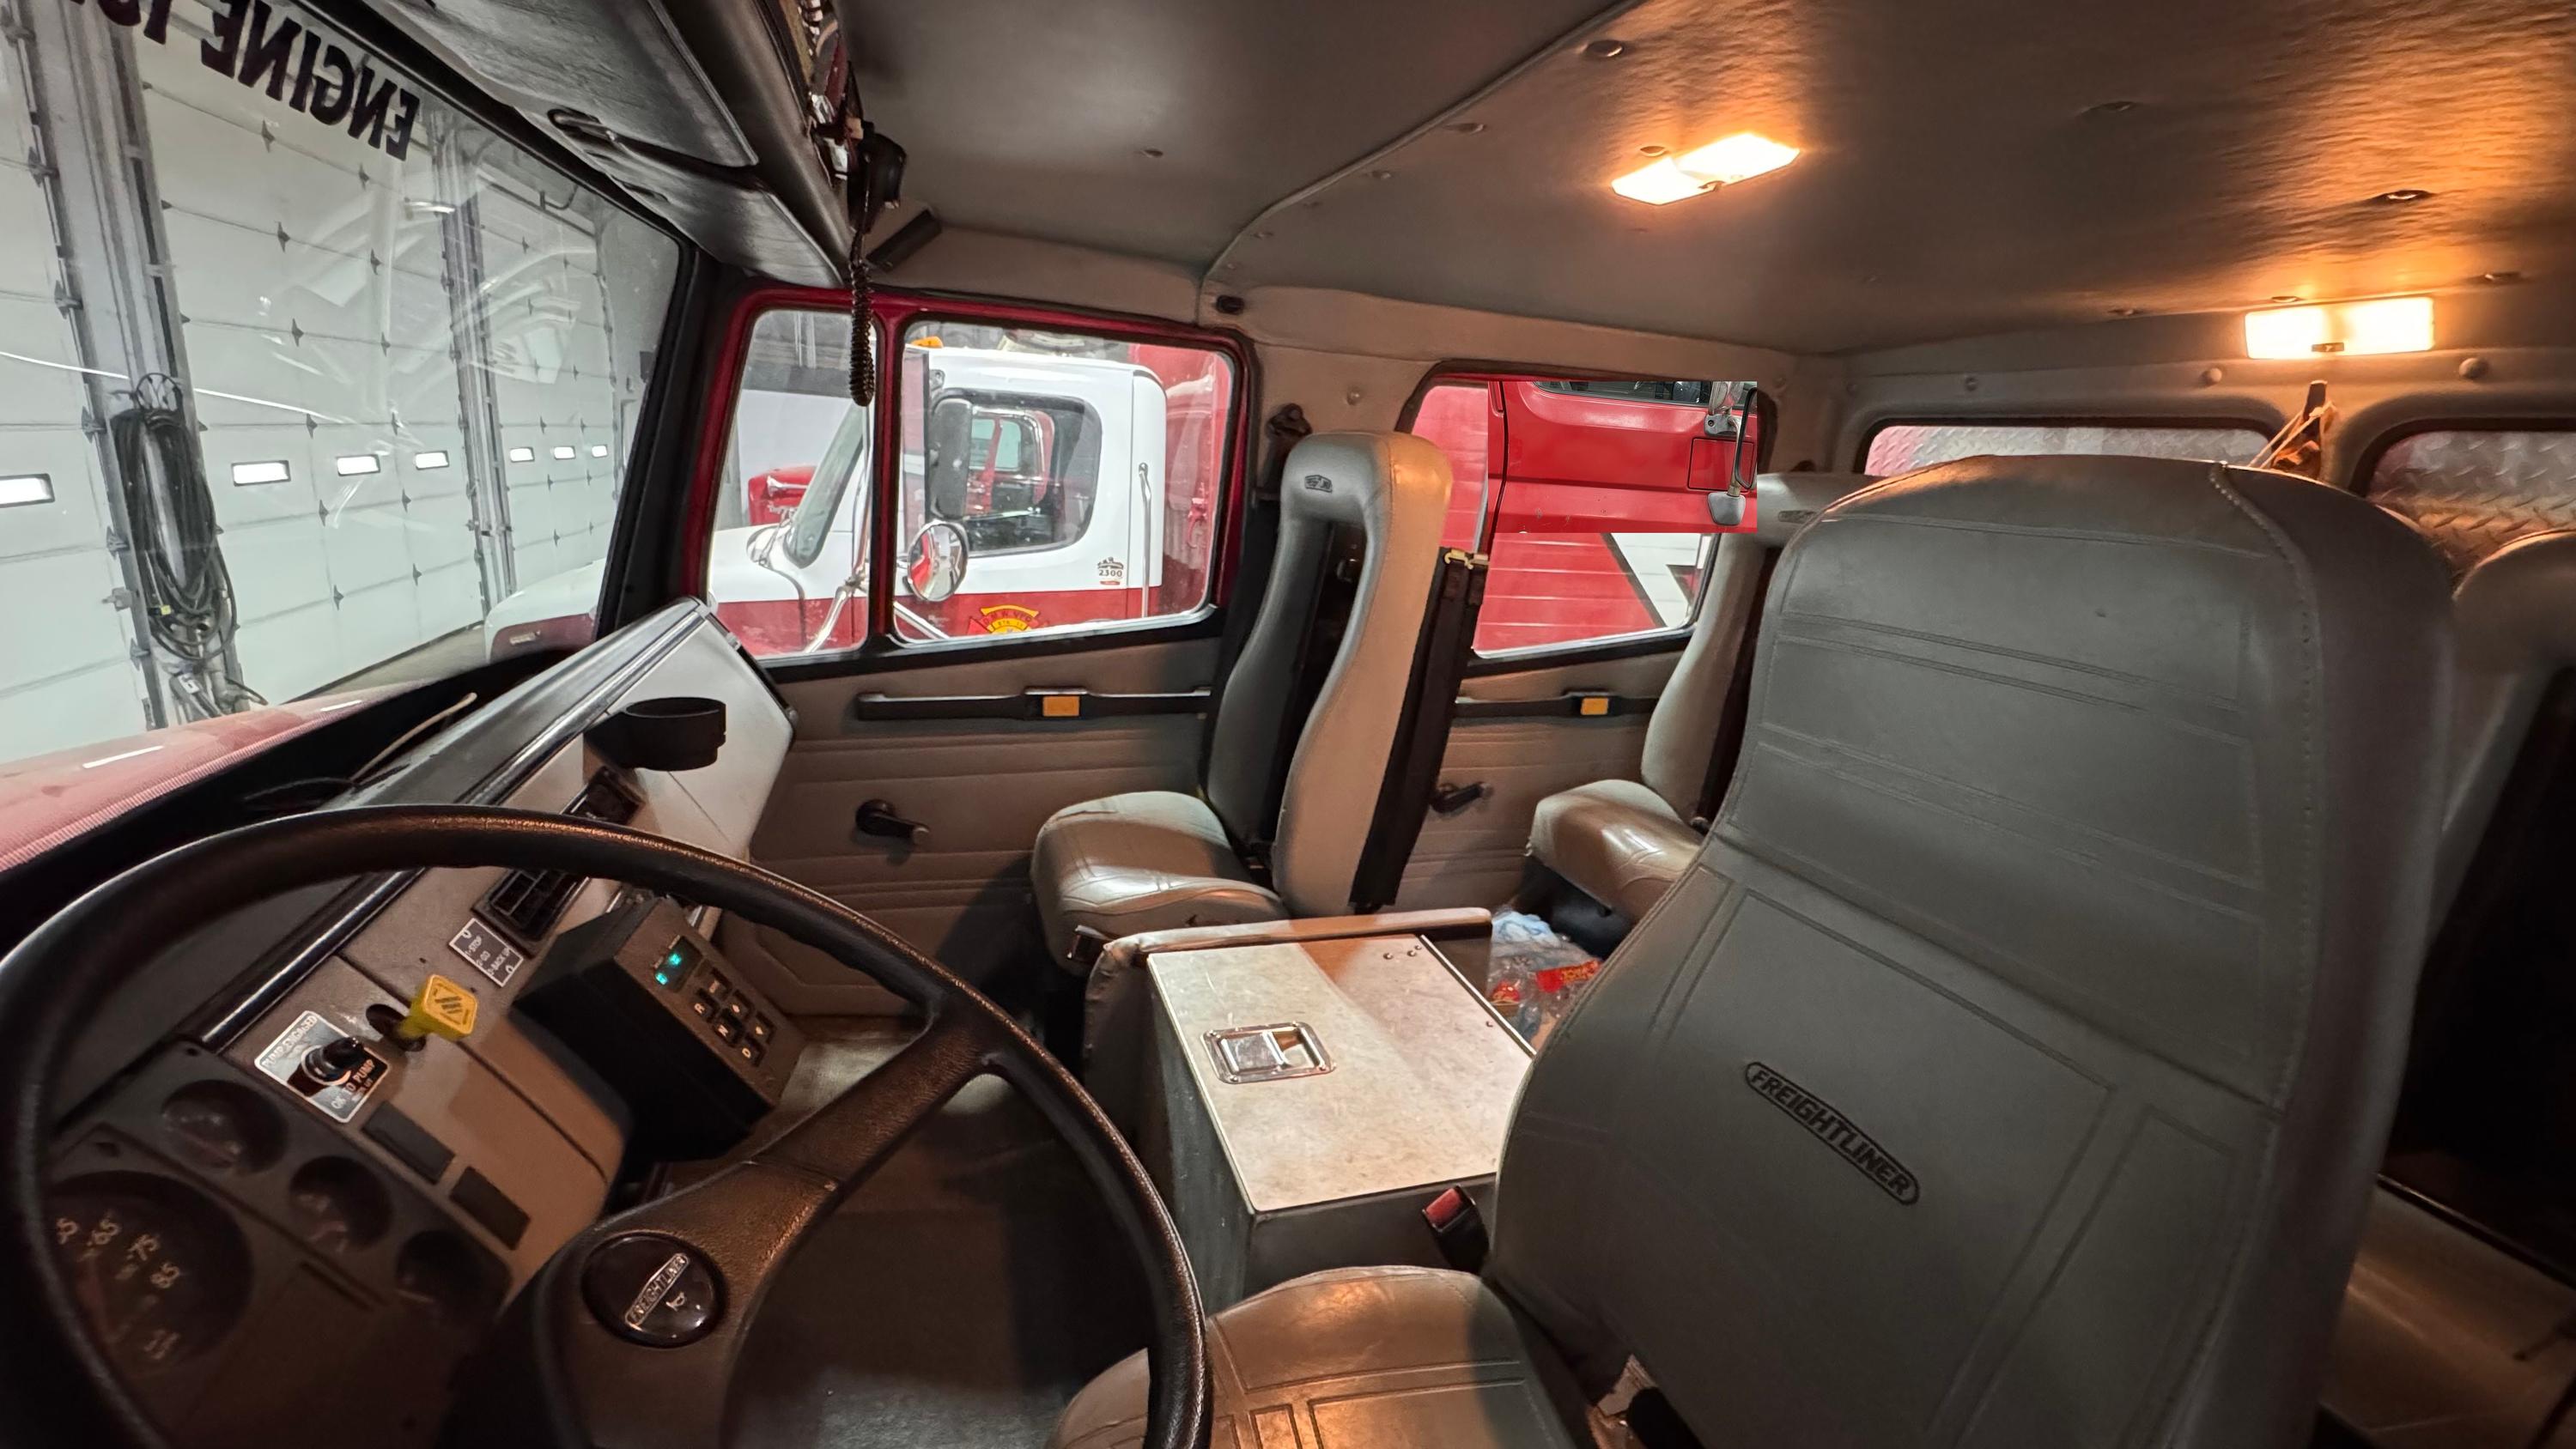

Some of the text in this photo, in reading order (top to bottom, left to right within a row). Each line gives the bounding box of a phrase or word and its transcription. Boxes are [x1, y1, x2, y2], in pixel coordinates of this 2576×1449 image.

[694, 1002, 705, 1014] R
[718, 1025, 729, 1037] N
[741, 1047, 751, 1058] D
[331, 1094, 347, 1109] OK
[342, 1082, 356, 1096] TO
[353, 1058, 375, 1083] PUMP
[1750, 1069, 1911, 1197] FREIGHTLINER
[629, 1256, 686, 1322] FREIGHTLINER
